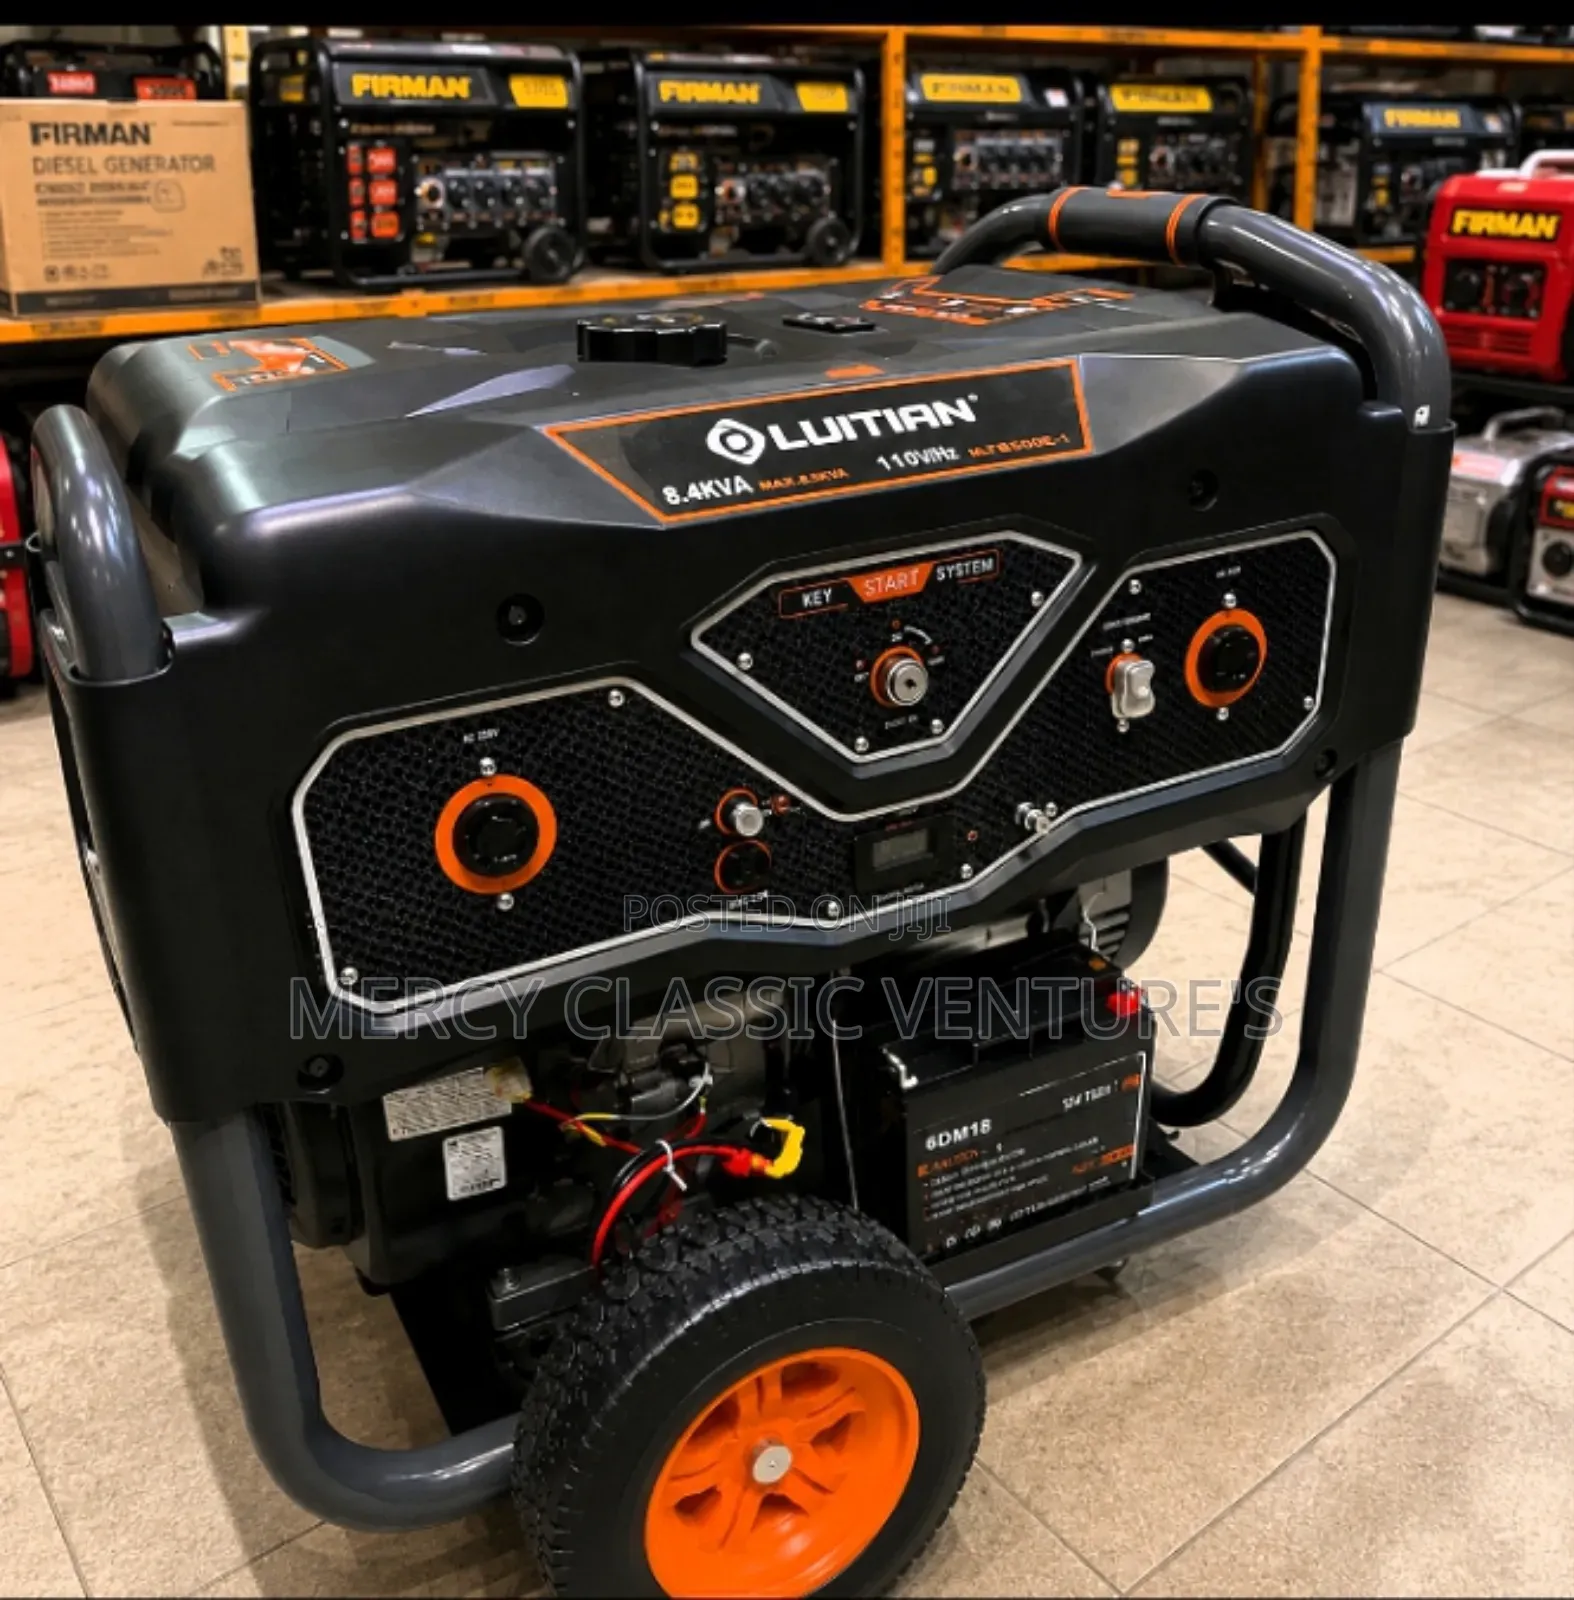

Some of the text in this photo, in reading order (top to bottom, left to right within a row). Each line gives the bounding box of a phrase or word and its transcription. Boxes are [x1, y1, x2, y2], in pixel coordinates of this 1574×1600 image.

[351, 73, 473, 99] FIRMAN
[657, 79, 762, 104] FIRMAN
[30, 122, 152, 147] FIRMAN
[32, 153, 217, 176] DIESEL GENERATOR
[1451, 208, 1561, 240] FIRMAN
[766, 396, 977, 452] LUITIAN
[661, 473, 755, 506] 8.4KVA
[801, 557, 995, 609] KEY START SYSTEM
[924, 1117, 993, 1152] 6DM18
